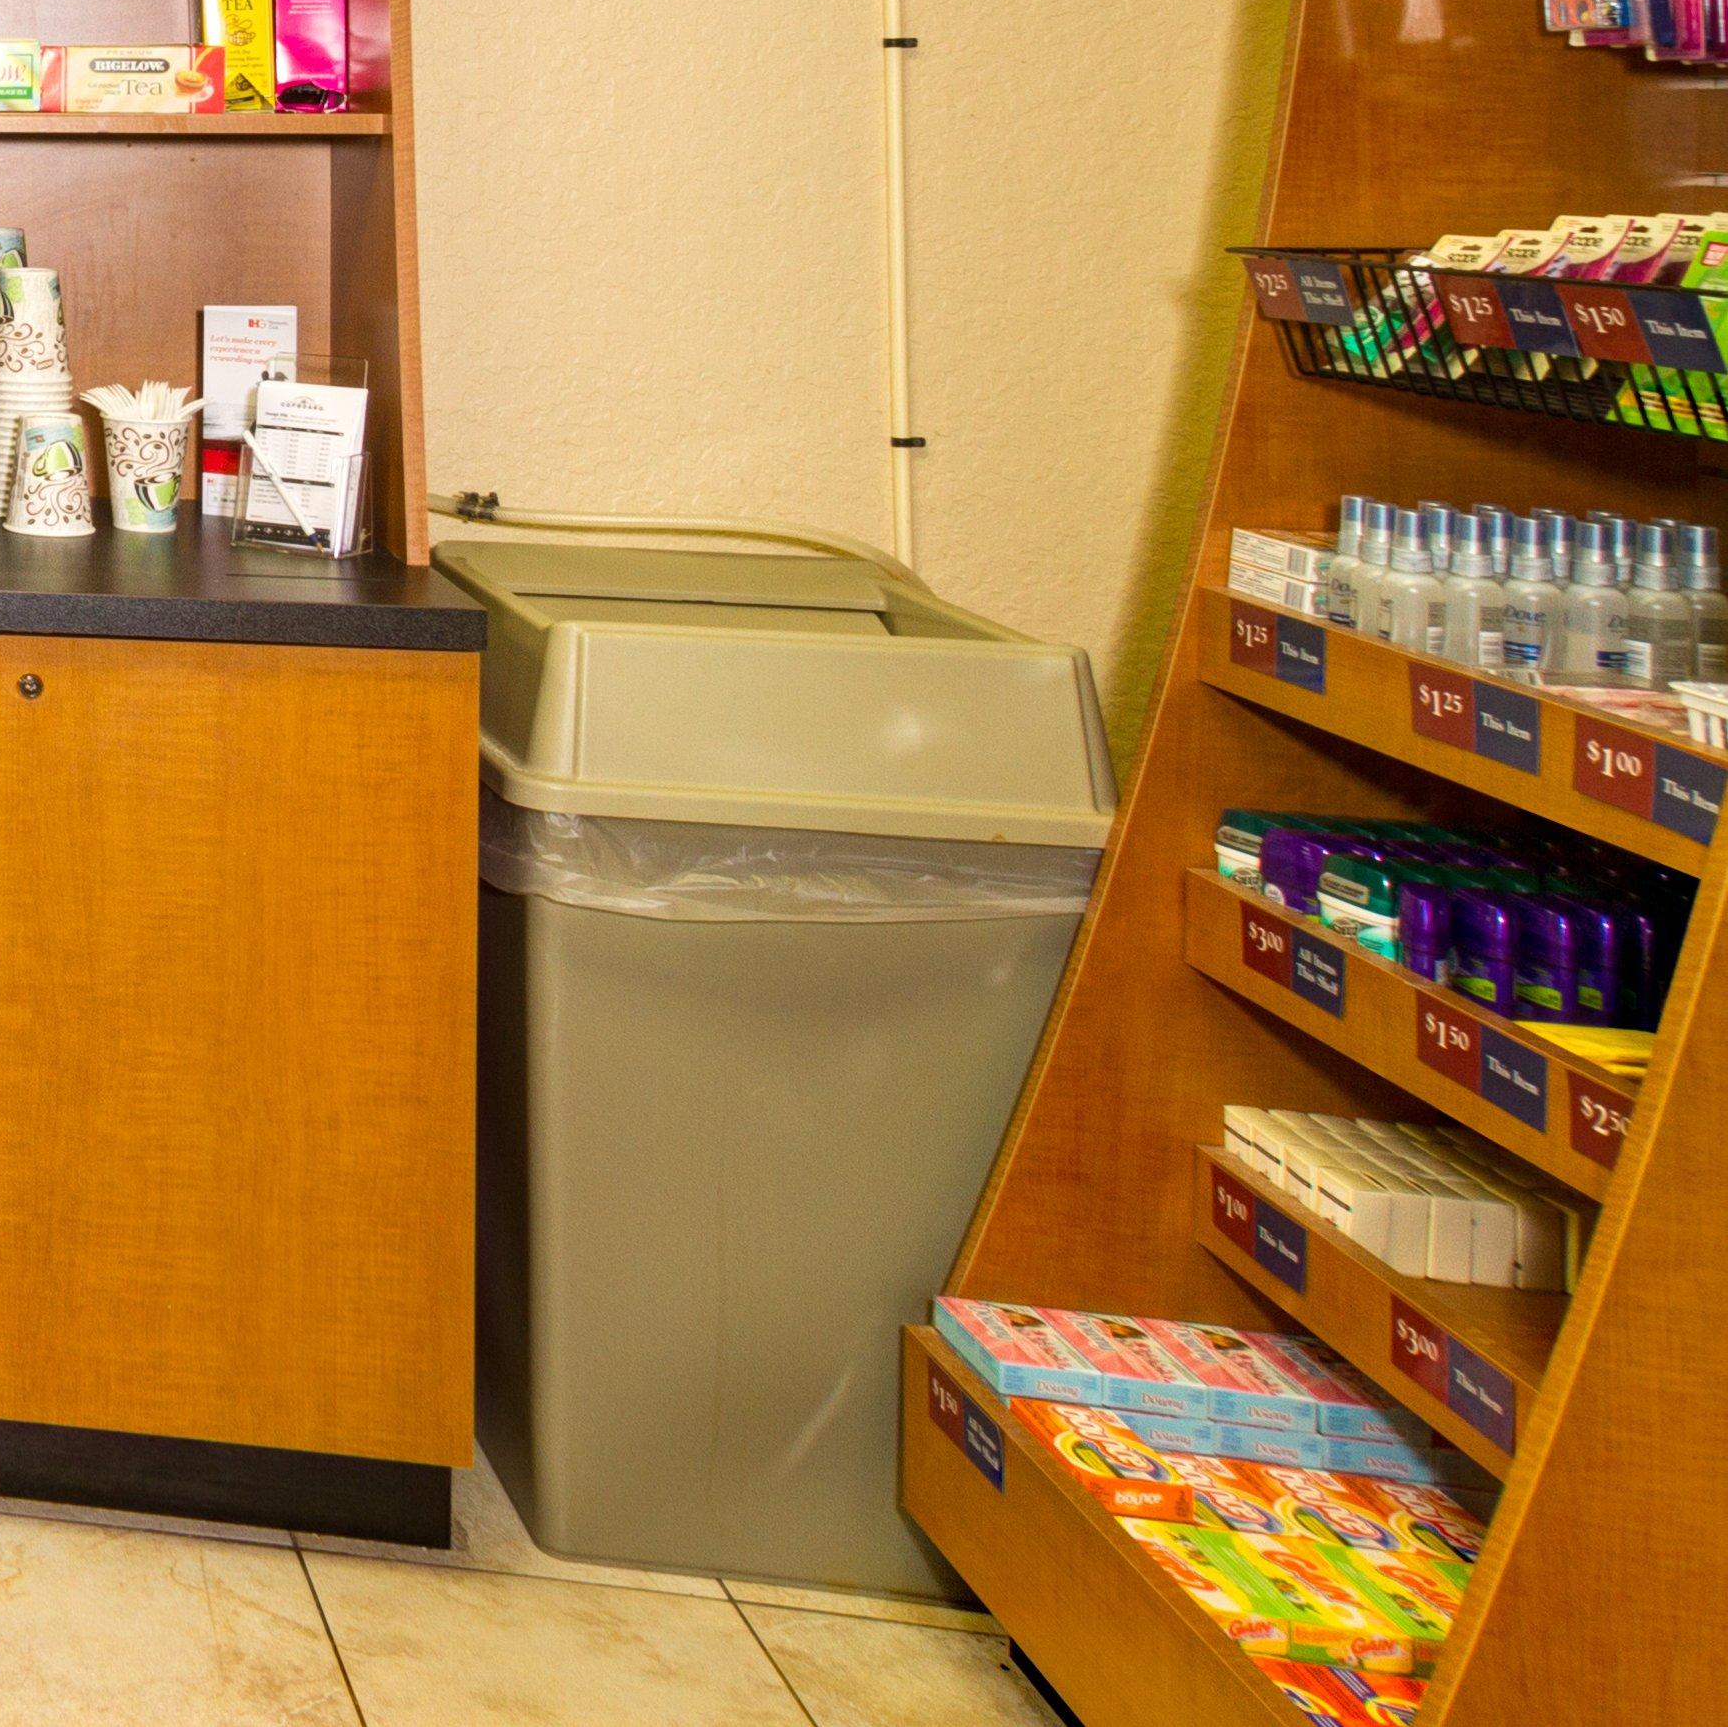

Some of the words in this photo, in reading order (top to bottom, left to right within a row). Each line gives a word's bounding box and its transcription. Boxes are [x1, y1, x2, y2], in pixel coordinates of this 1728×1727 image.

[121, 79, 163, 96] Tea
[1509, 308, 1535, 324] This
[1537, 311, 1562, 327] Item
[1645, 318, 1675, 337] This
[1677, 322, 1707, 339] Item
[1505, 604, 1546, 622] Dove
[1280, 641, 1301, 658] This
[1301, 648, 1319, 665] Item
[1480, 712, 1506, 731] This
[1507, 720, 1532, 742] Item
[1662, 777, 1691, 802] This
[1691, 788, 1719, 815] Item
[1485, 1054, 1512, 1082] This
[1511, 1069, 1539, 1097] Item
[1114, 1491, 1162, 1507] bounce
